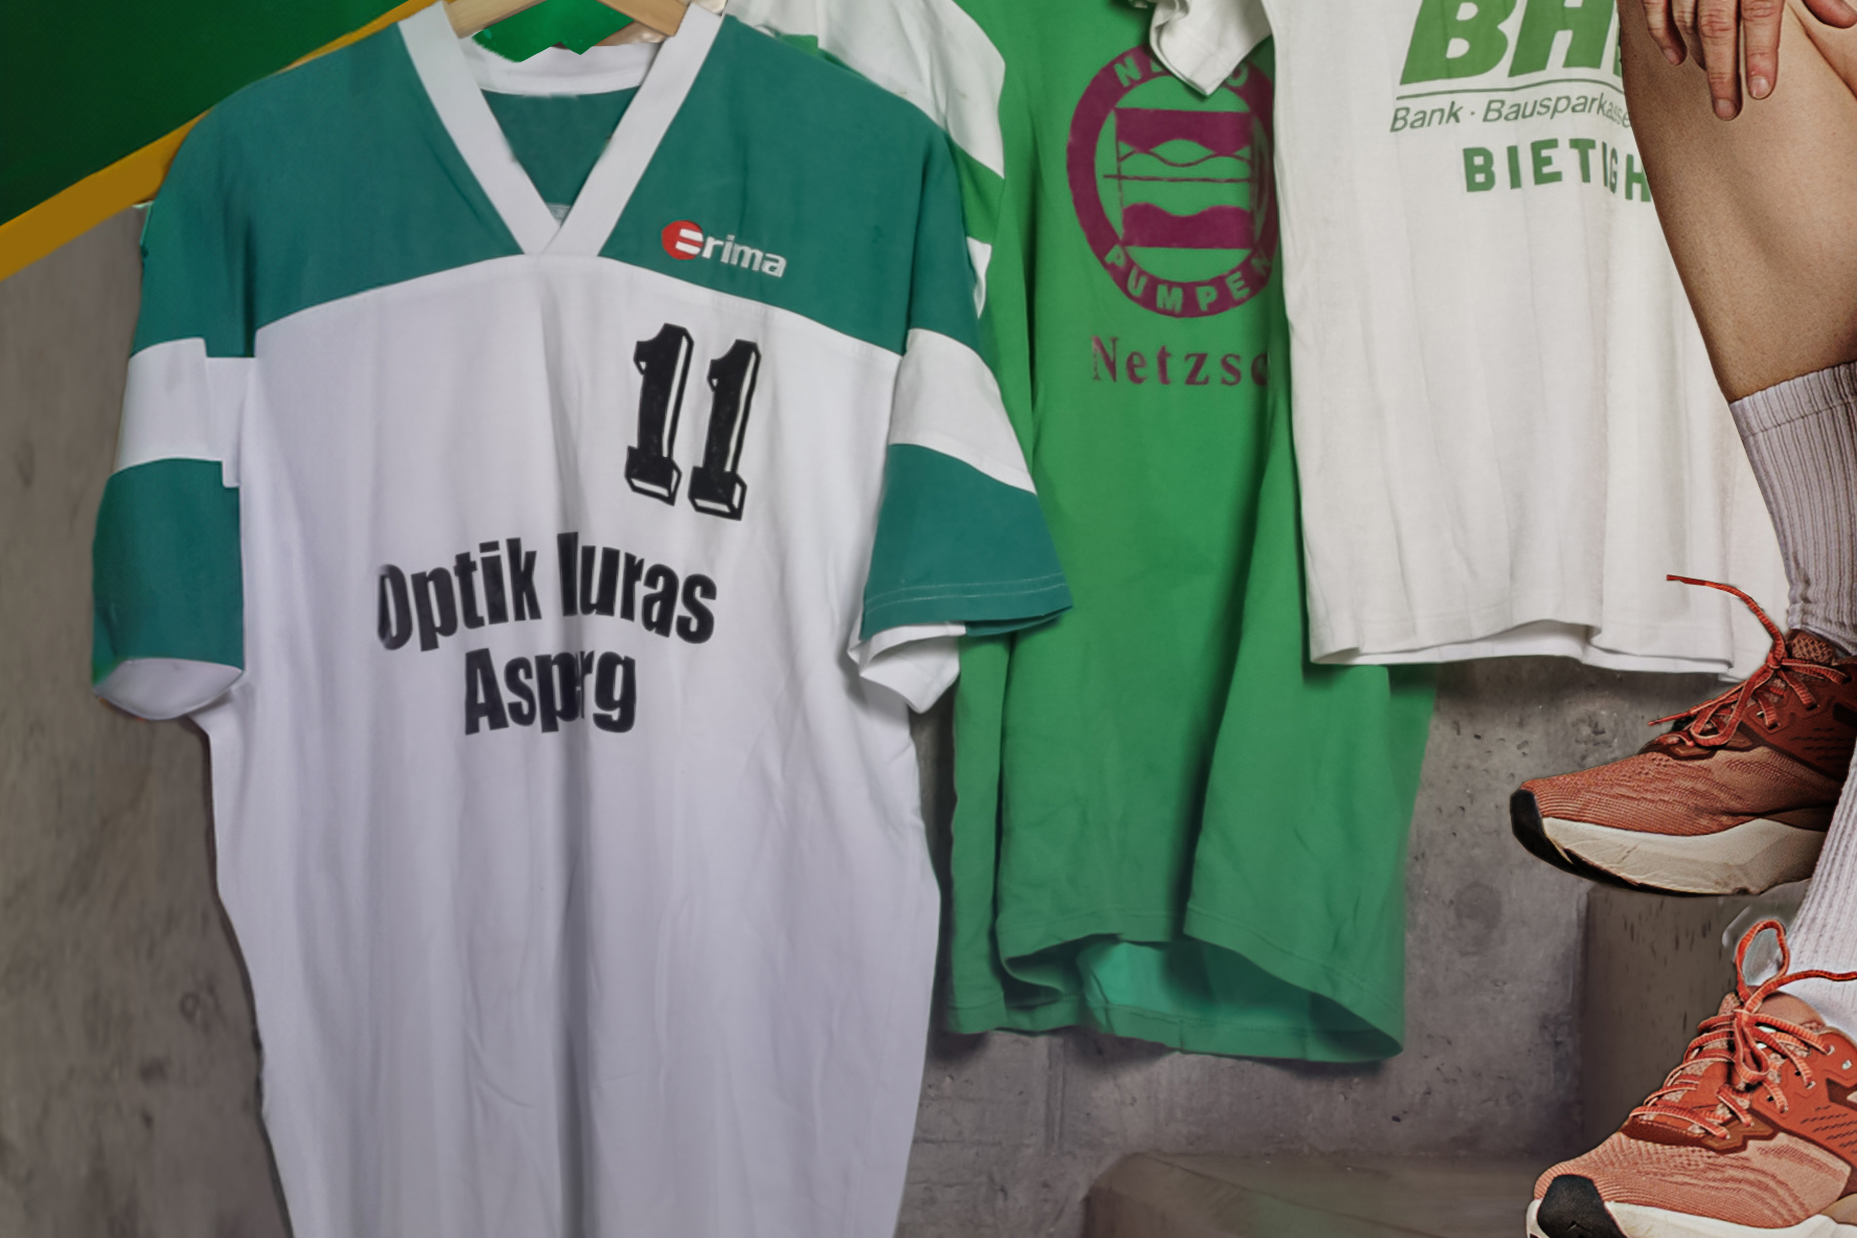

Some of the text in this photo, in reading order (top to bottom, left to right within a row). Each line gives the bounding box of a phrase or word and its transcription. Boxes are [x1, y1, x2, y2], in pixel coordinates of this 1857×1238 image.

[1390, 101, 1464, 133] Bank
[1463, 138, 1652, 202] BIETIGH
[1104, 244, 1272, 314] PUMPEN
[624, 322, 762, 522] 11
[377, 537, 542, 652] Optik
